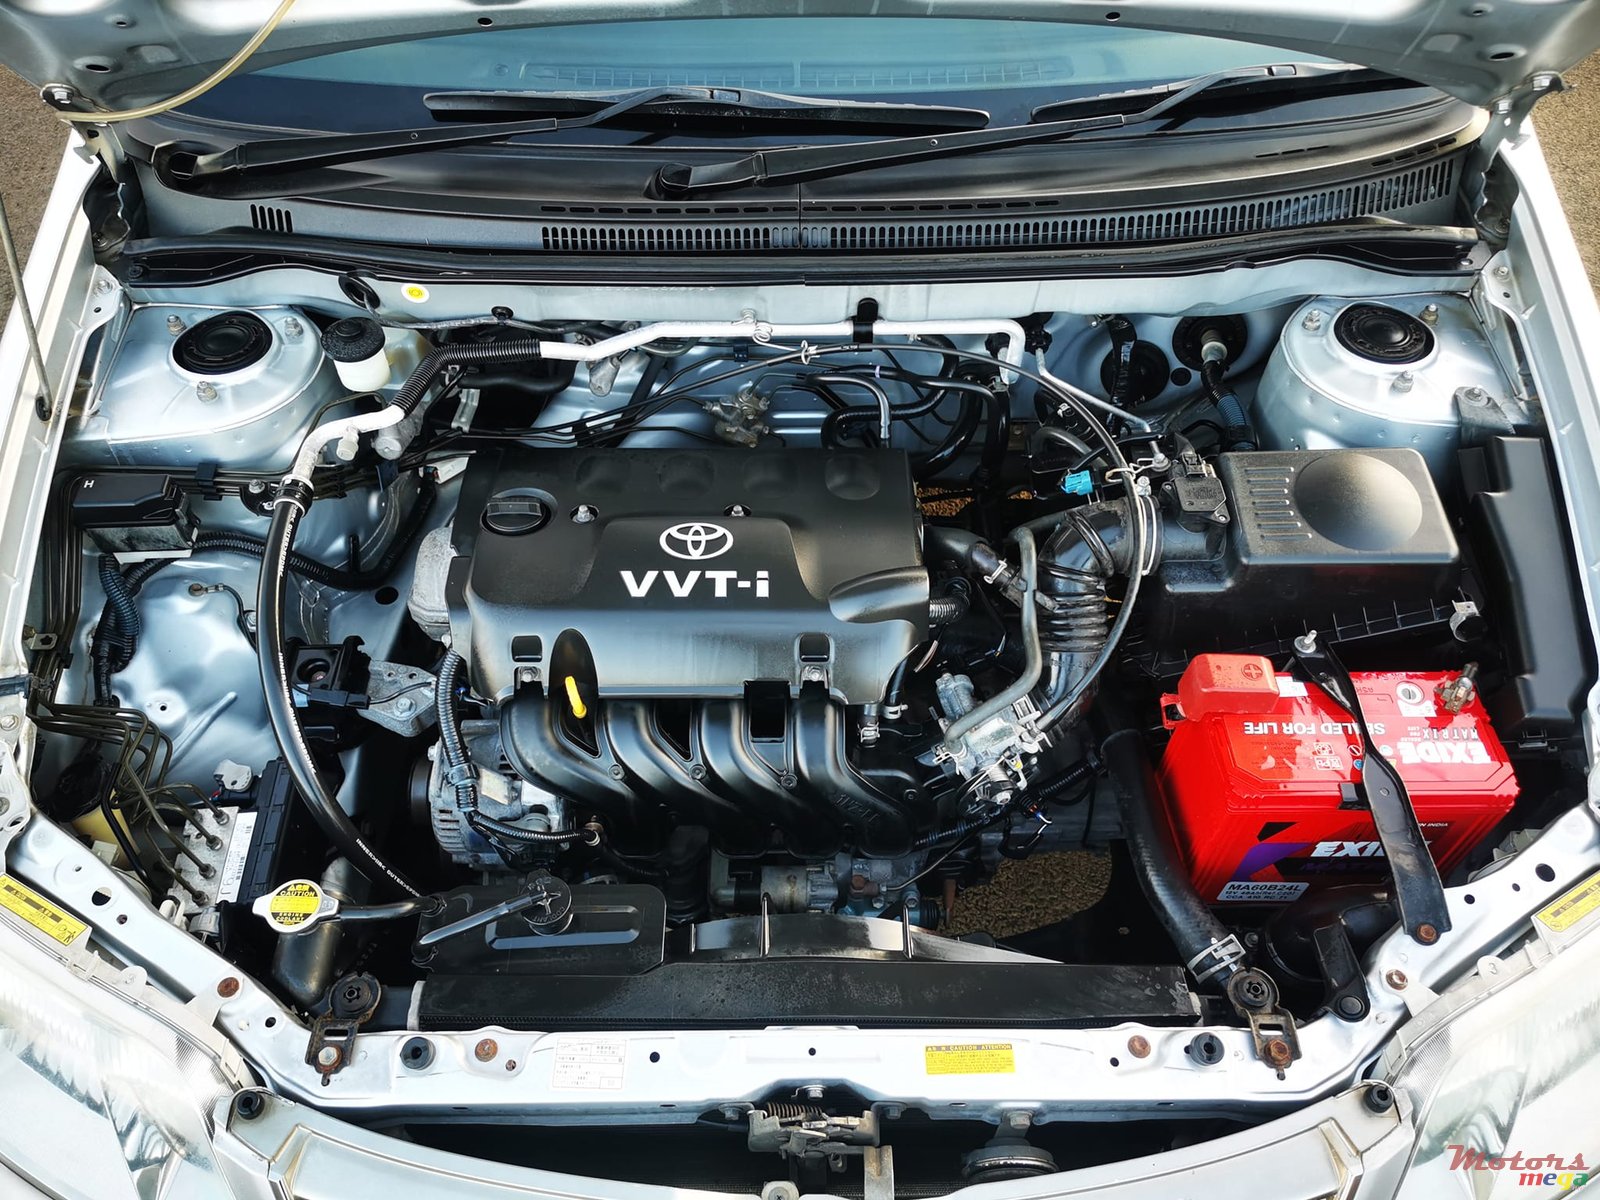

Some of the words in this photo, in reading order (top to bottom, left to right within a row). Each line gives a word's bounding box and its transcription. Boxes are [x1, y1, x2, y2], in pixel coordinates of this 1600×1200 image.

[83, 479, 95, 488] H
[619, 570, 769, 598] VVT-i
[1243, 722, 1278, 735] LIFE
[1281, 722, 1316, 735] FOR
[1422, 727, 1479, 741] MATRIX
[1396, 741, 1491, 764] EXIDE
[1310, 841, 1386, 857] EXI
